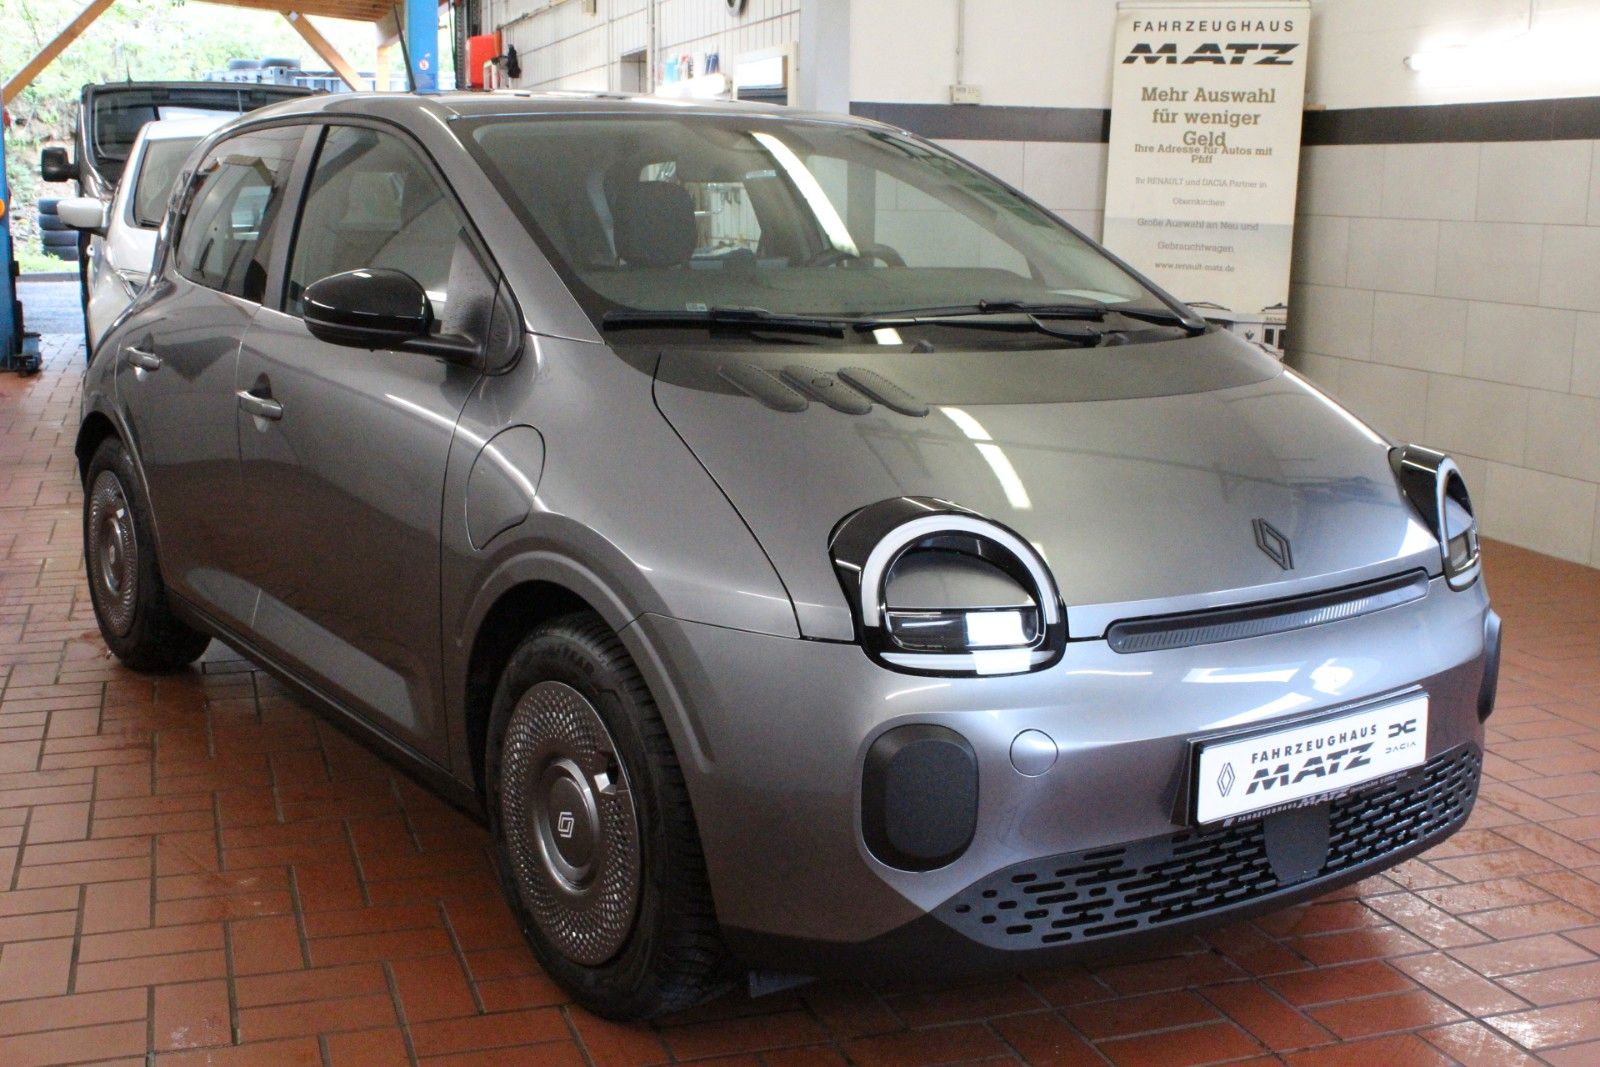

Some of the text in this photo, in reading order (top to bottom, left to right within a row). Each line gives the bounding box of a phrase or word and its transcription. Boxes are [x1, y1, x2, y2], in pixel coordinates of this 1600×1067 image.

[1133, 20, 1294, 32] FAHRZEUGHAUS
[1122, 43, 1299, 65] MATZ
[1141, 87, 1276, 103] Mehr Auswahl
[1152, 109, 1261, 128] für weniger
[1183, 131, 1226, 147] Geld
[1135, 144, 1272, 156] Ihre Adresse für Autos mit
[1147, 177, 1184, 186] RENAULT
[1186, 178, 1200, 186] und
[1202, 178, 1228, 187] DACIA
[1165, 219, 1205, 229] Auswahl
[1241, 223, 1259, 231] und
[1252, 724, 1377, 764] FAHRZEUGHAUS
[1385, 741, 1416, 754] DACIA
[1245, 741, 1376, 795] MATZ
